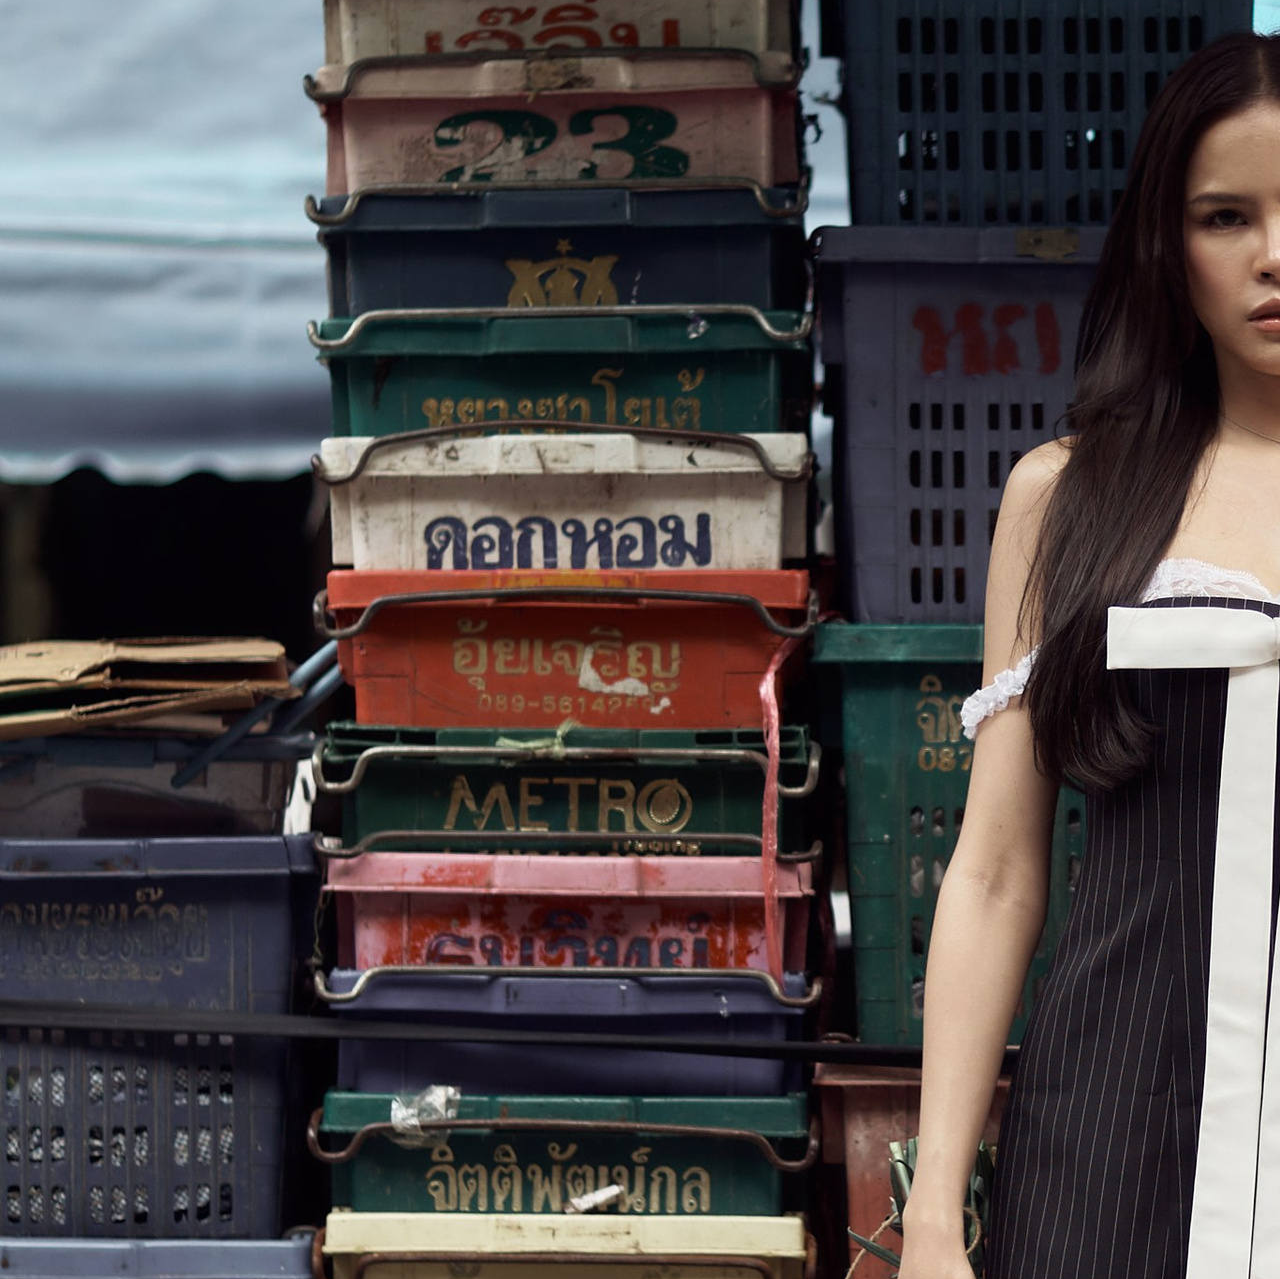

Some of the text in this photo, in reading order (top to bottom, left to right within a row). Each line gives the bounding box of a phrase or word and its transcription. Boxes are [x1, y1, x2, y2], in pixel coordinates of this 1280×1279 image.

[424, 512, 712, 569] ดอกหอม
[444, 776, 693, 834] METRO
